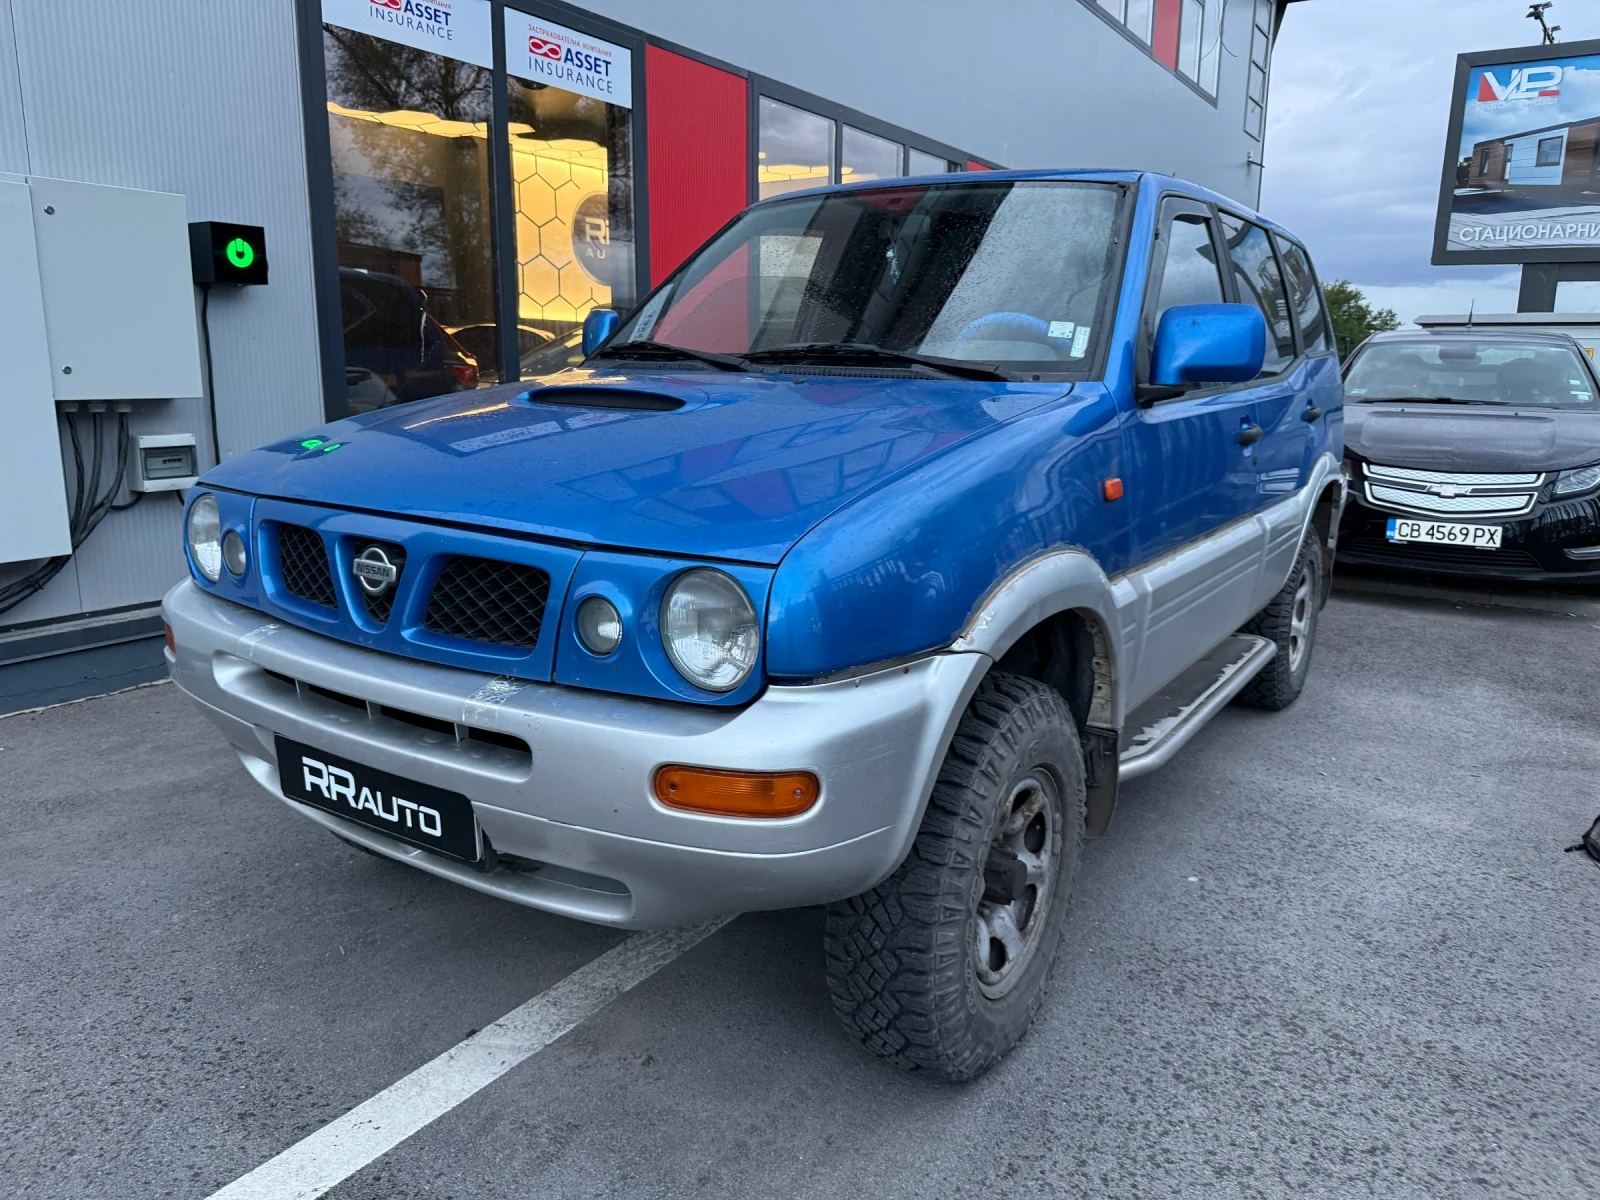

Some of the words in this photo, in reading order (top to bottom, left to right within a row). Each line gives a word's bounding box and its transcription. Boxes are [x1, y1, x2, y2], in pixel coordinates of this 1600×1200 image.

[369, 5, 453, 41] INSURANCE
[403, 0, 452, 26] ASSET
[528, 24, 581, 47] ЗАСТРАХОВАТЕЛНА
[582, 42, 612, 57] КОМПАНИЯ
[528, 56, 613, 94] INSURANCE
[564, 47, 612, 77] ASSET
[1398, 522, 1421, 539] CB
[1425, 524, 1470, 543] 4569
[1473, 527, 1499, 545] PX
[356, 562, 390, 578] NISSAN
